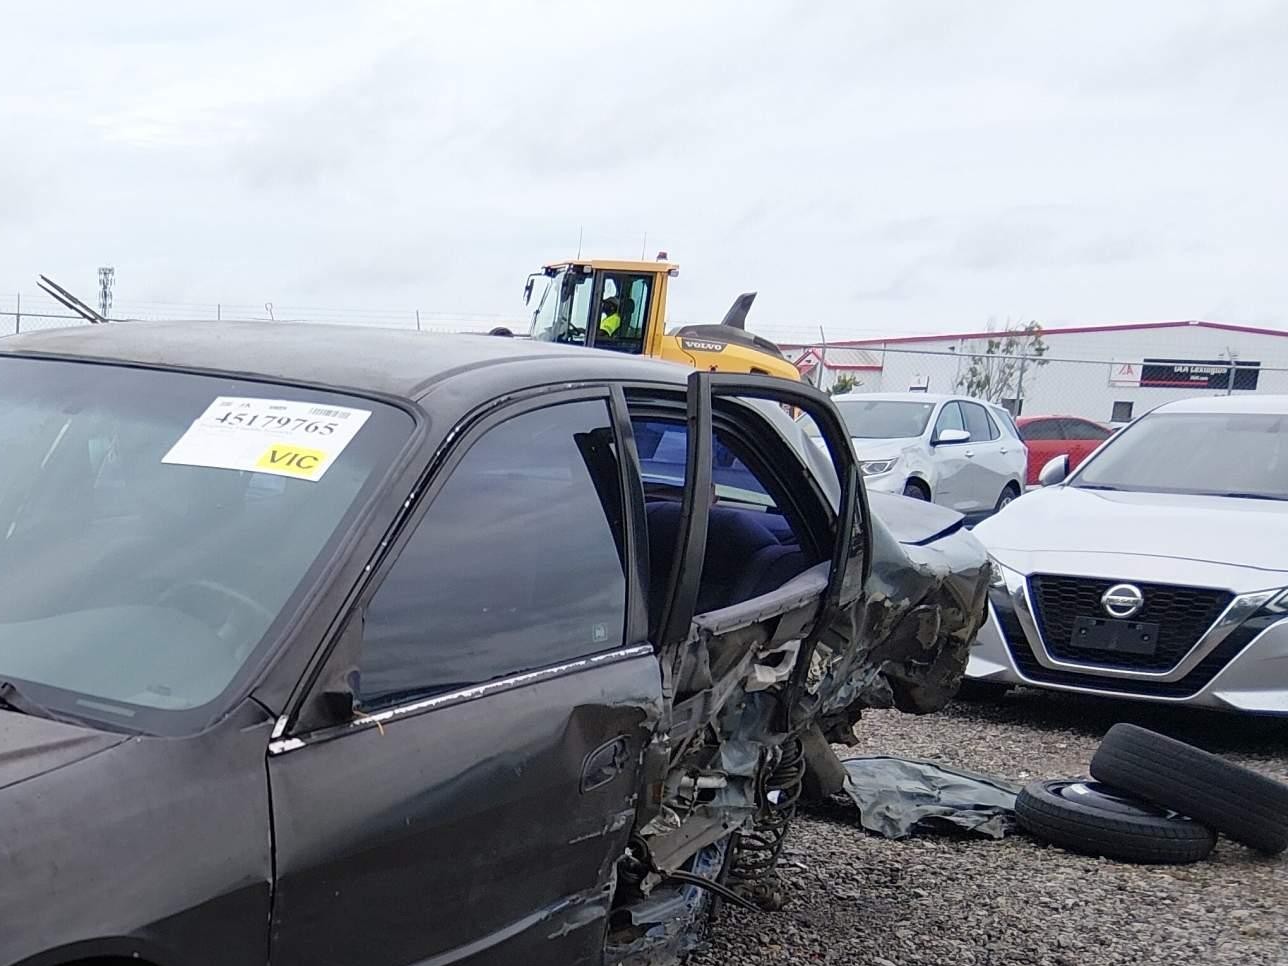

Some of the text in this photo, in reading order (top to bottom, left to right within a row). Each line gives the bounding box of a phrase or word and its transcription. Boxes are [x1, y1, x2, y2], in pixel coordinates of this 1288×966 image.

[685, 341, 722, 351] VOLVO
[215, 412, 339, 436] 45179765
[270, 450, 319, 470] VIC
